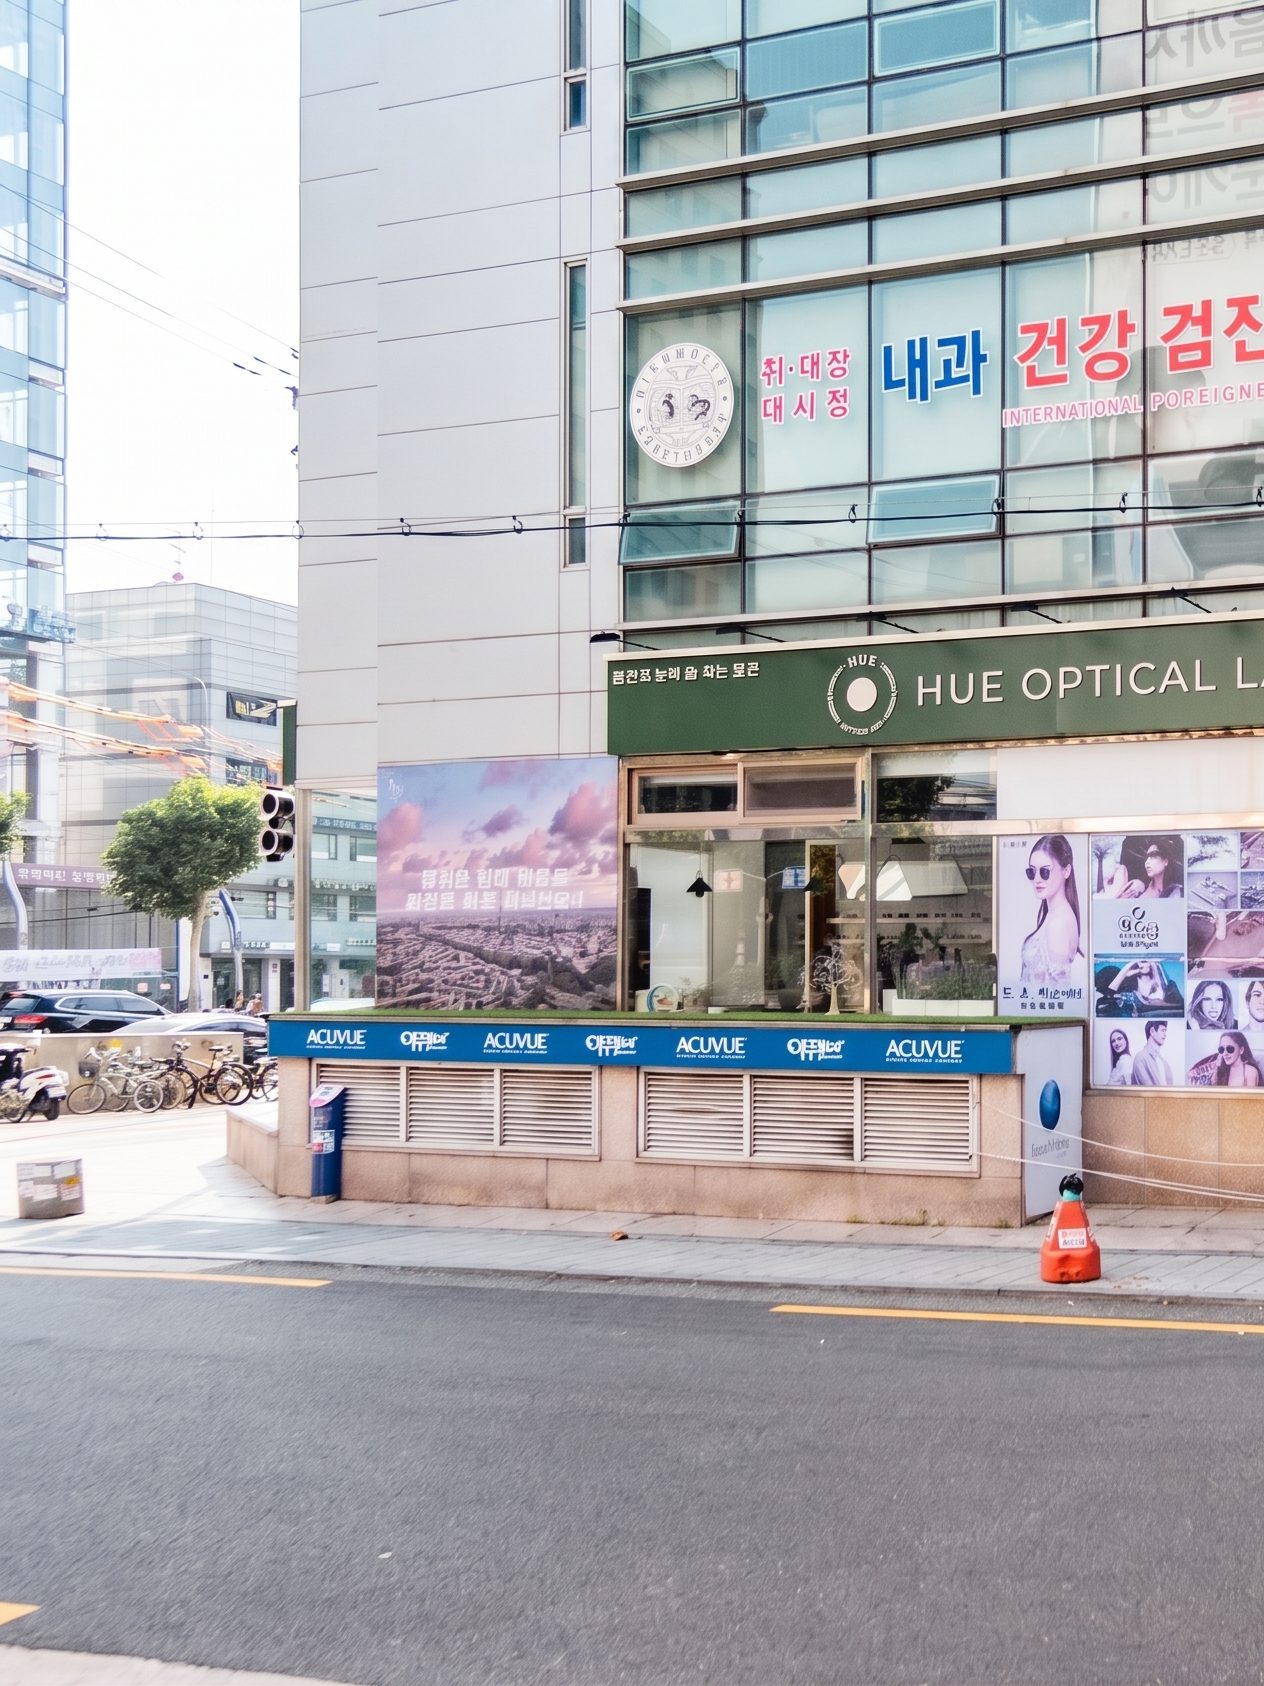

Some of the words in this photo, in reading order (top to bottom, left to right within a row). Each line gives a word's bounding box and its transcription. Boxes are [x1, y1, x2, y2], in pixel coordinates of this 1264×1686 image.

[883, 330, 988, 402] 내과
[1018, 310, 1138, 389] 건강
[1003, 398, 1142, 427] INTERNATIONAL
[847, 654, 878, 669] HUE
[917, 671, 1004, 707] HUE
[1022, 659, 1218, 701] OPTICAL
[307, 1029, 367, 1046] ACUVUE
[484, 1033, 548, 1049] ACUVUE
[676, 1037, 746, 1054] ACUVUE
[886, 1040, 963, 1058] ACUVUE
